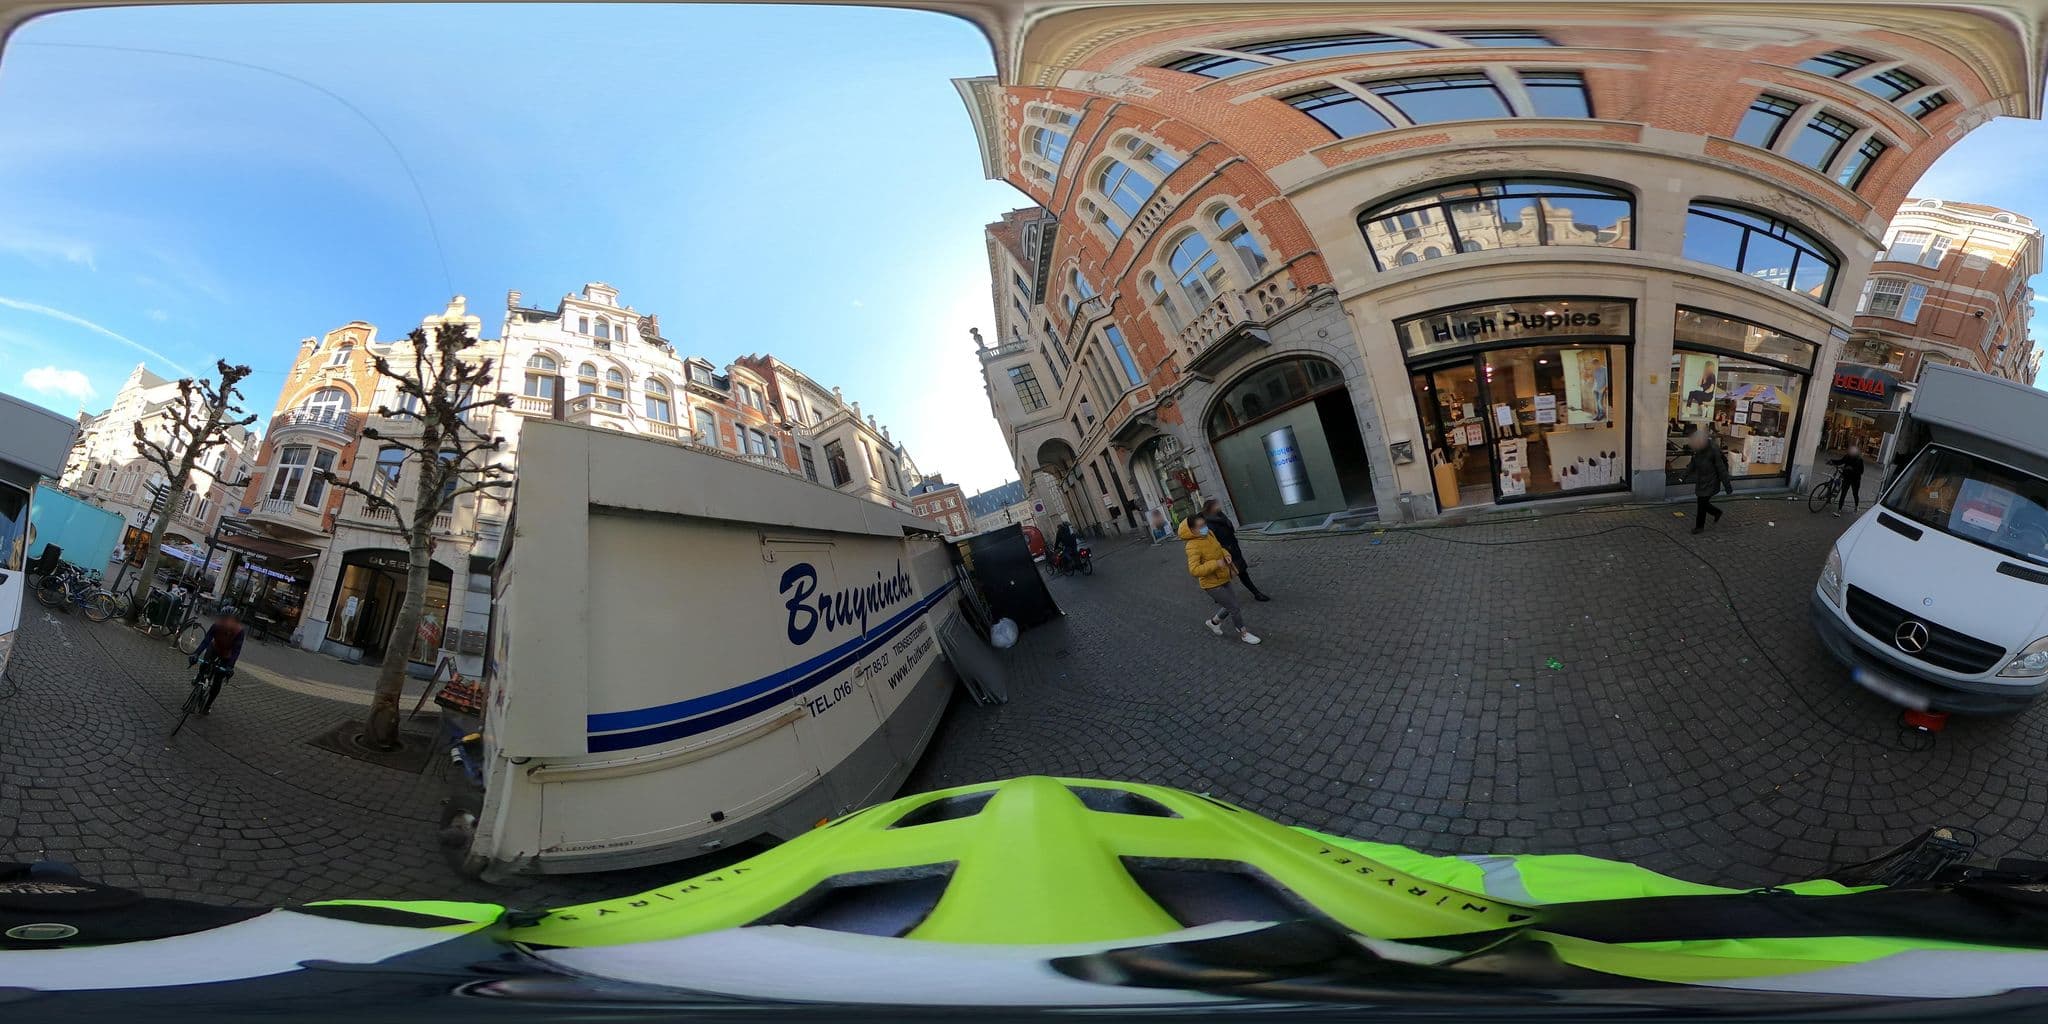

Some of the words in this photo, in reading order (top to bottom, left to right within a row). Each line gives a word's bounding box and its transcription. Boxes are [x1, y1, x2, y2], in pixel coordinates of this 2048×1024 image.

[1431, 316, 1496, 343] Hush
[1503, 309, 1601, 332] Puppies
[1834, 373, 1885, 396] HEMA
[780, 558, 913, 646] Bruyninckx
